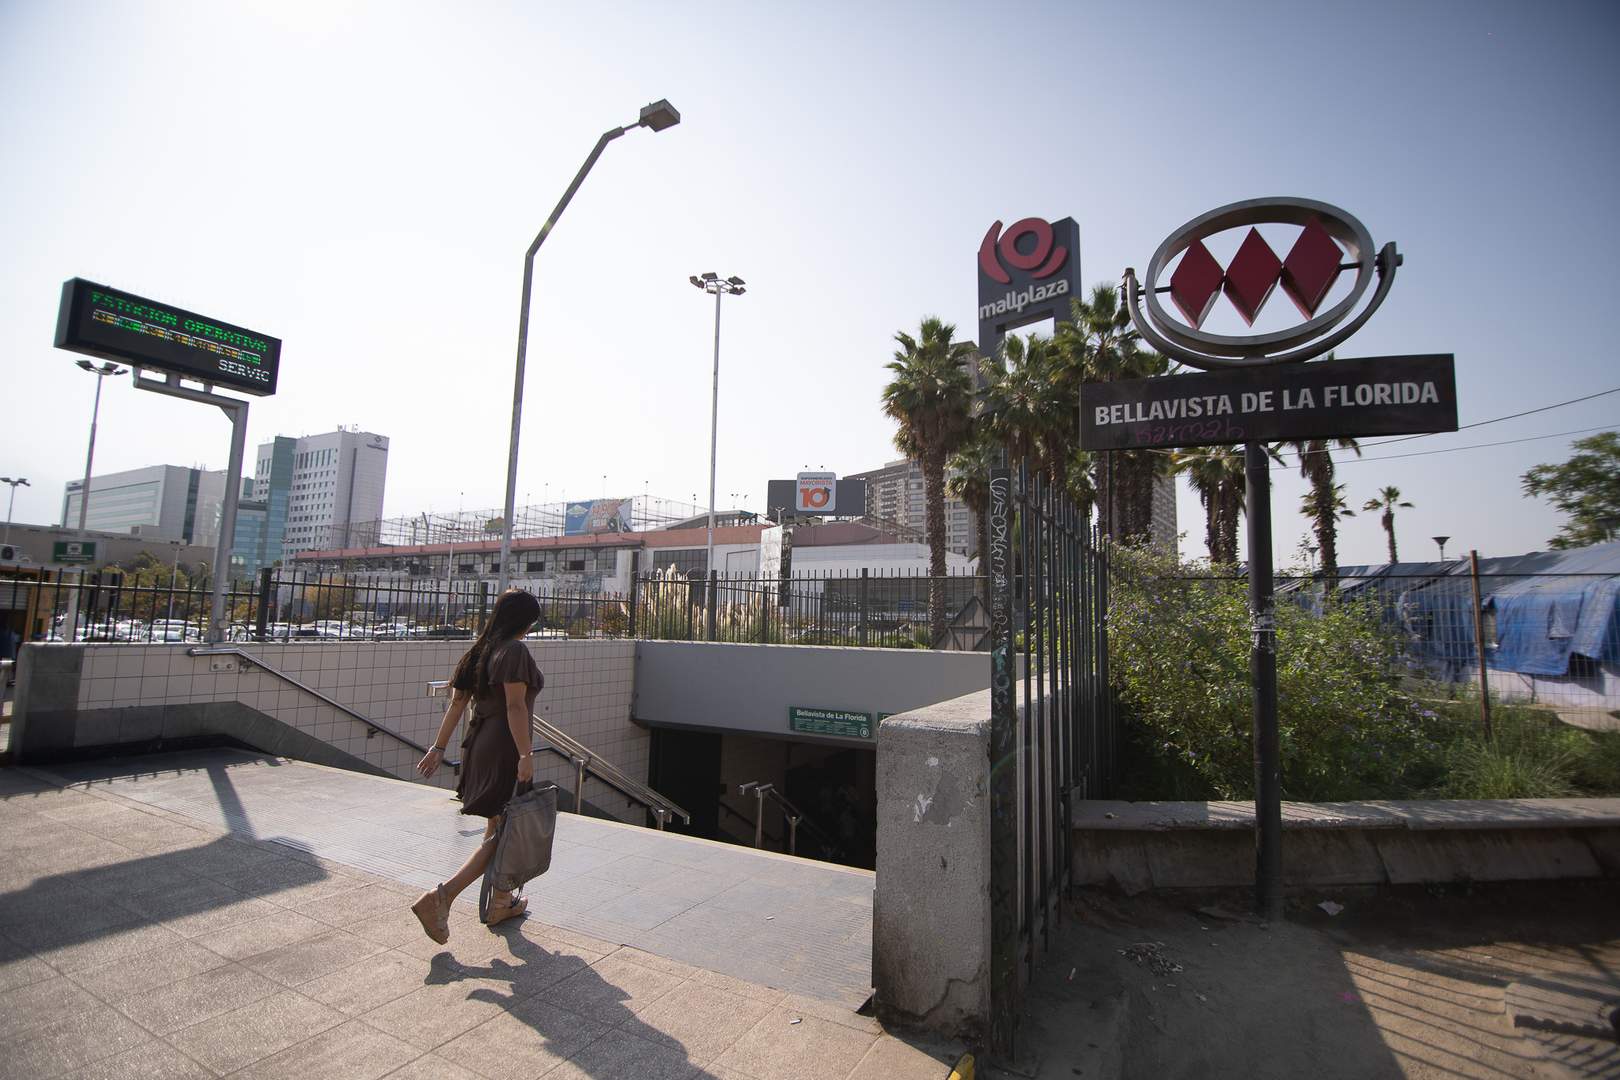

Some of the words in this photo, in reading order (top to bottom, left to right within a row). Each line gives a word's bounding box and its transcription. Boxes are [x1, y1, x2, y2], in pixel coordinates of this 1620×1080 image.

[980, 279, 1069, 319] mallplaza
[218, 359, 270, 382] SERVIC
[1095, 394, 1233, 426] BELLAVISTA
[1241, 390, 1274, 414] DE
[1282, 388, 1315, 410] LA
[1323, 381, 1439, 407] FLORIDA
[800, 487, 830, 508] 10
[796, 709, 825, 718] Bellavista
[844, 713, 867, 722] Florida
